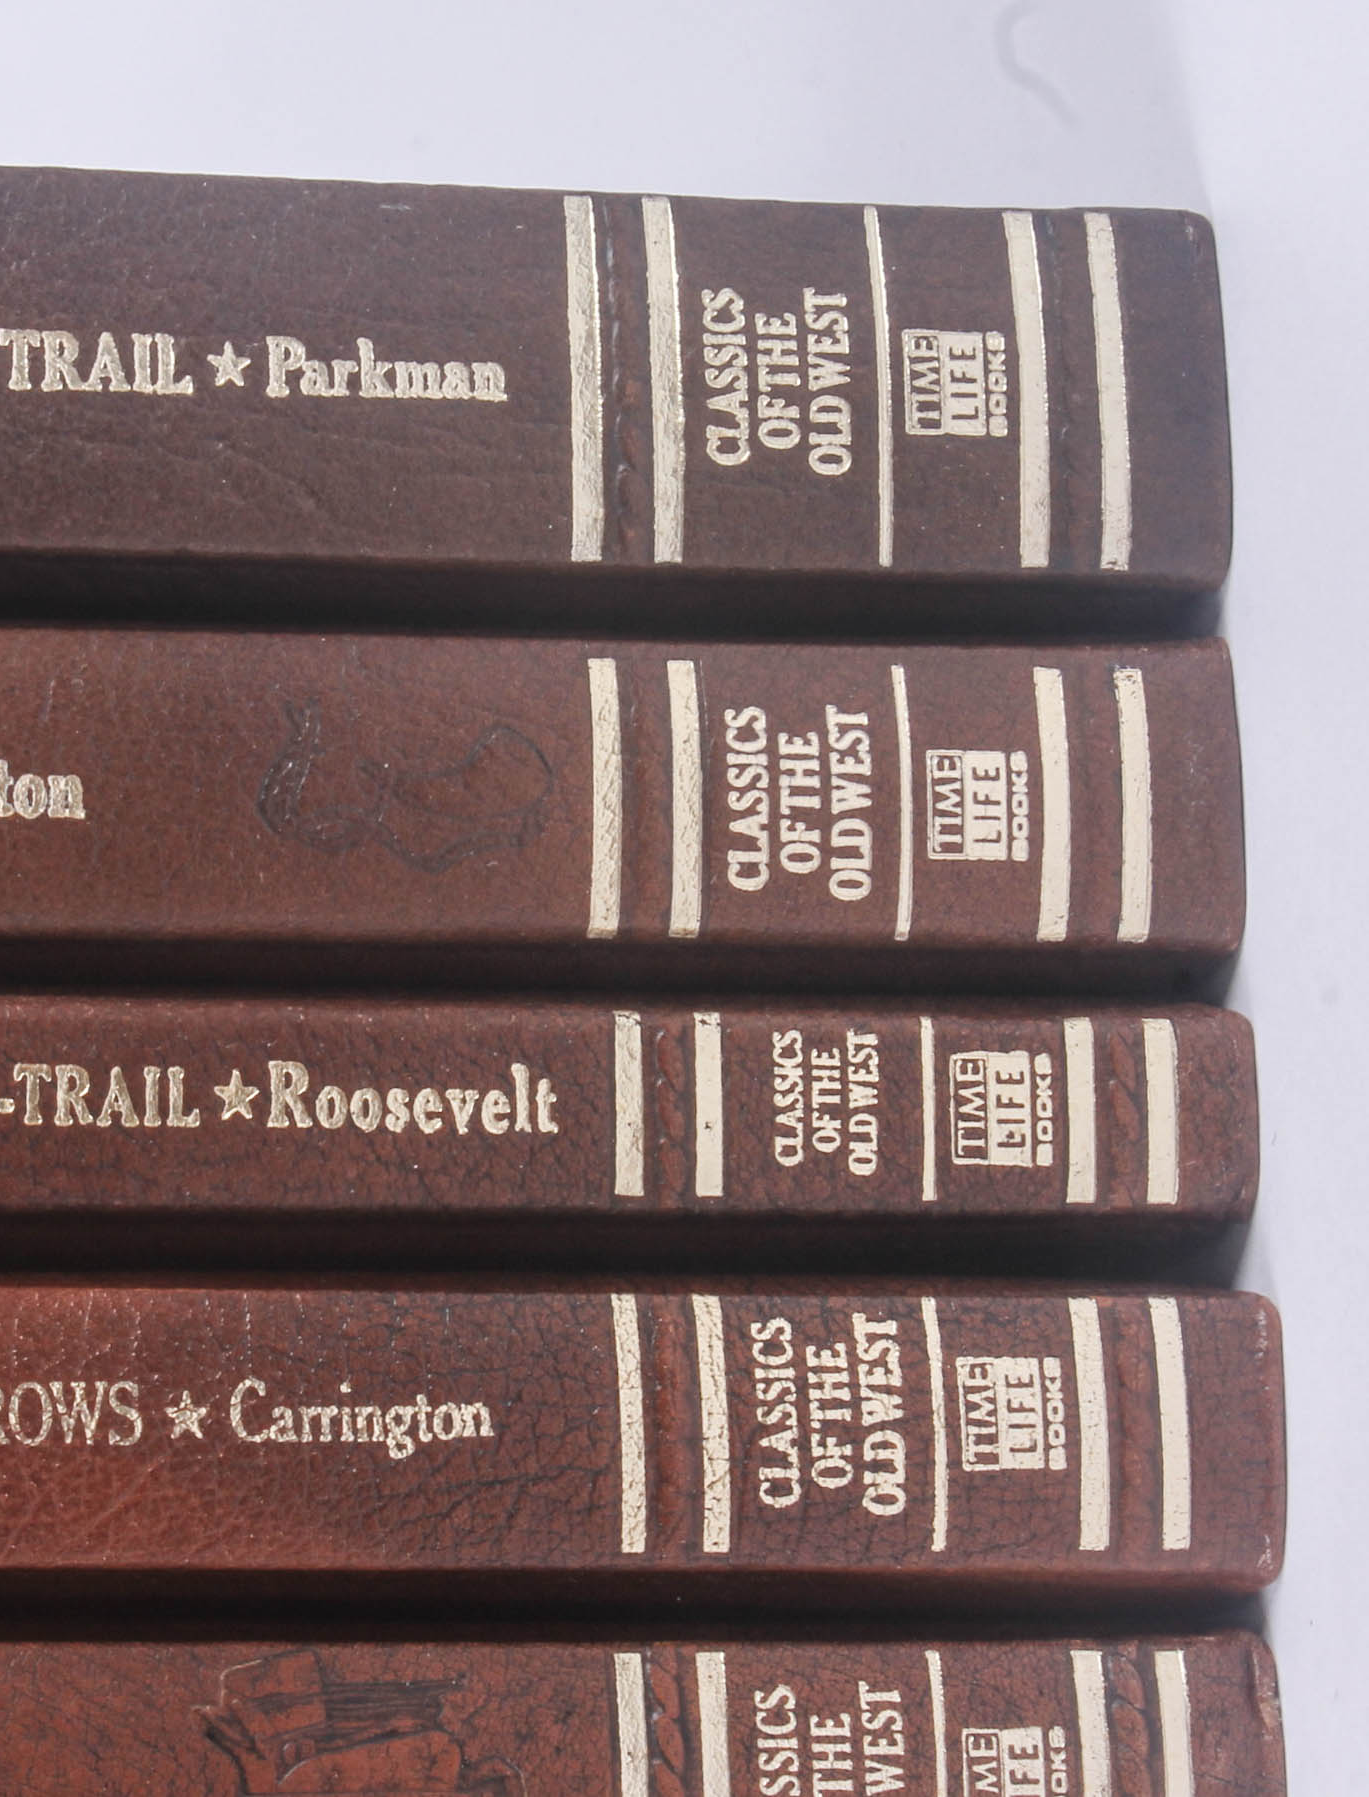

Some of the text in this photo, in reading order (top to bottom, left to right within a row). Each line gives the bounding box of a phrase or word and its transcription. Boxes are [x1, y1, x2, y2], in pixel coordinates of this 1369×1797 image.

[0, 328, 193, 395] TRAIL
[266, 336, 507, 401] Parkman
[701, 287, 750, 466] CLASSICS
[755, 312, 801, 450] OF THE
[803, 287, 852, 476] OLD WEST
[909, 336, 941, 428] TIME
[950, 347, 978, 420] LIFE
[725, 706, 769, 891] CLASSICS
[778, 731, 822, 874] OF THE
[826, 704, 873, 900] OLD WEST
[932, 756, 962, 852] TIME
[972, 767, 1001, 843] LIFE
[267, 1060, 559, 1134] Roosevelt
[773, 1030, 804, 1166] CLASSICS
[811, 1048, 841, 1153] OF THE
[847, 1028, 879, 1176] OLD WEST
[955, 1060, 985, 1155] TIME
[995, 1071, 1026, 1147] LIFE
[230, 1378, 493, 1459] Carrington
[751, 1317, 801, 1508] CLASSICS
[806, 1343, 853, 1489] OF THE
[852, 1312, 906, 1516] OLD WEST
[964, 1364, 996, 1462] TIME
[1005, 1373, 1037, 1452] LIFE
[754, 1684, 800, 1797] SSICS
[810, 1713, 854, 1797] THE
[859, 1681, 905, 1796] WEST
[969, 1736, 999, 1796] ME
[1049, 1726, 1068, 1797] OKS
